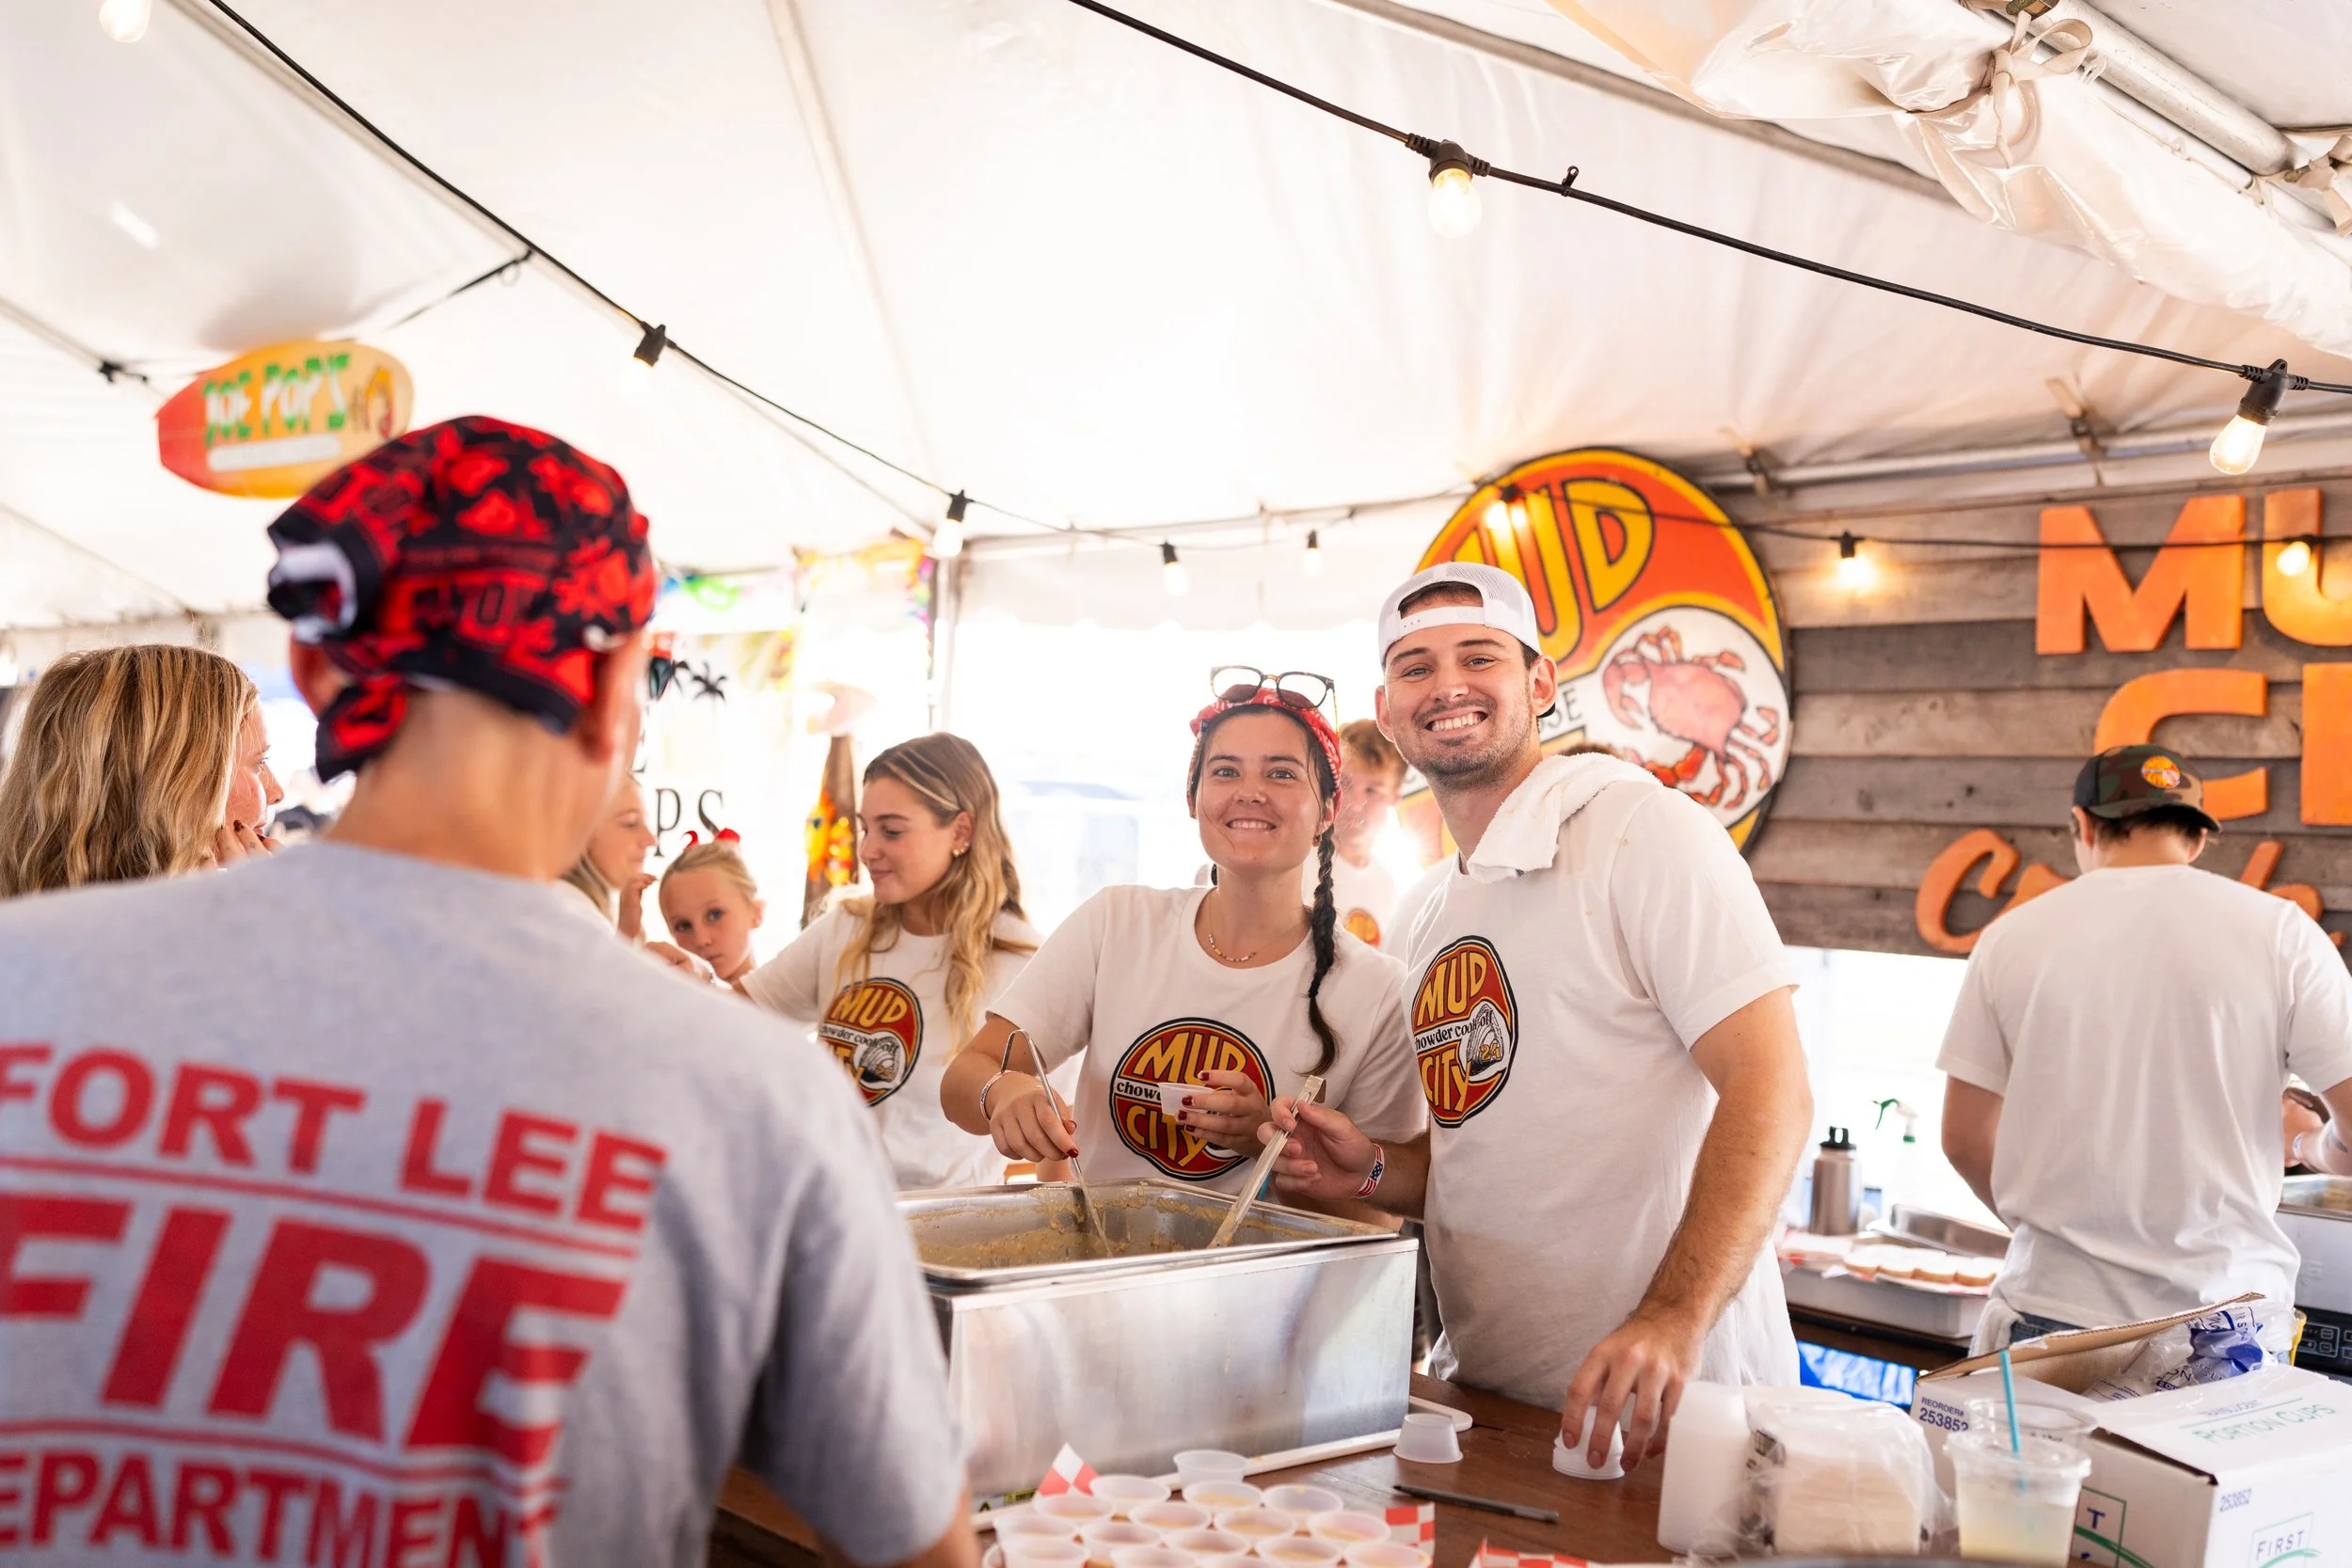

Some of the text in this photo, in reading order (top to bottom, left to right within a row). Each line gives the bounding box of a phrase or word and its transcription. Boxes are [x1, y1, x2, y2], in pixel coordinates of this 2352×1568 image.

[831, 987, 909, 1028] MUD
[1417, 951, 1487, 1027] MUD
[1132, 1032, 1248, 1088] MUD
[1421, 1048, 1471, 1113] CITY
[0, 1042, 670, 1232] FORT LEE
[1126, 1103, 1209, 1167] CITY
[0, 1190, 630, 1471] FIRE
[1921, 1396, 1964, 1418] REORDER#
[2255, 1529, 2305, 1562] FIRST
